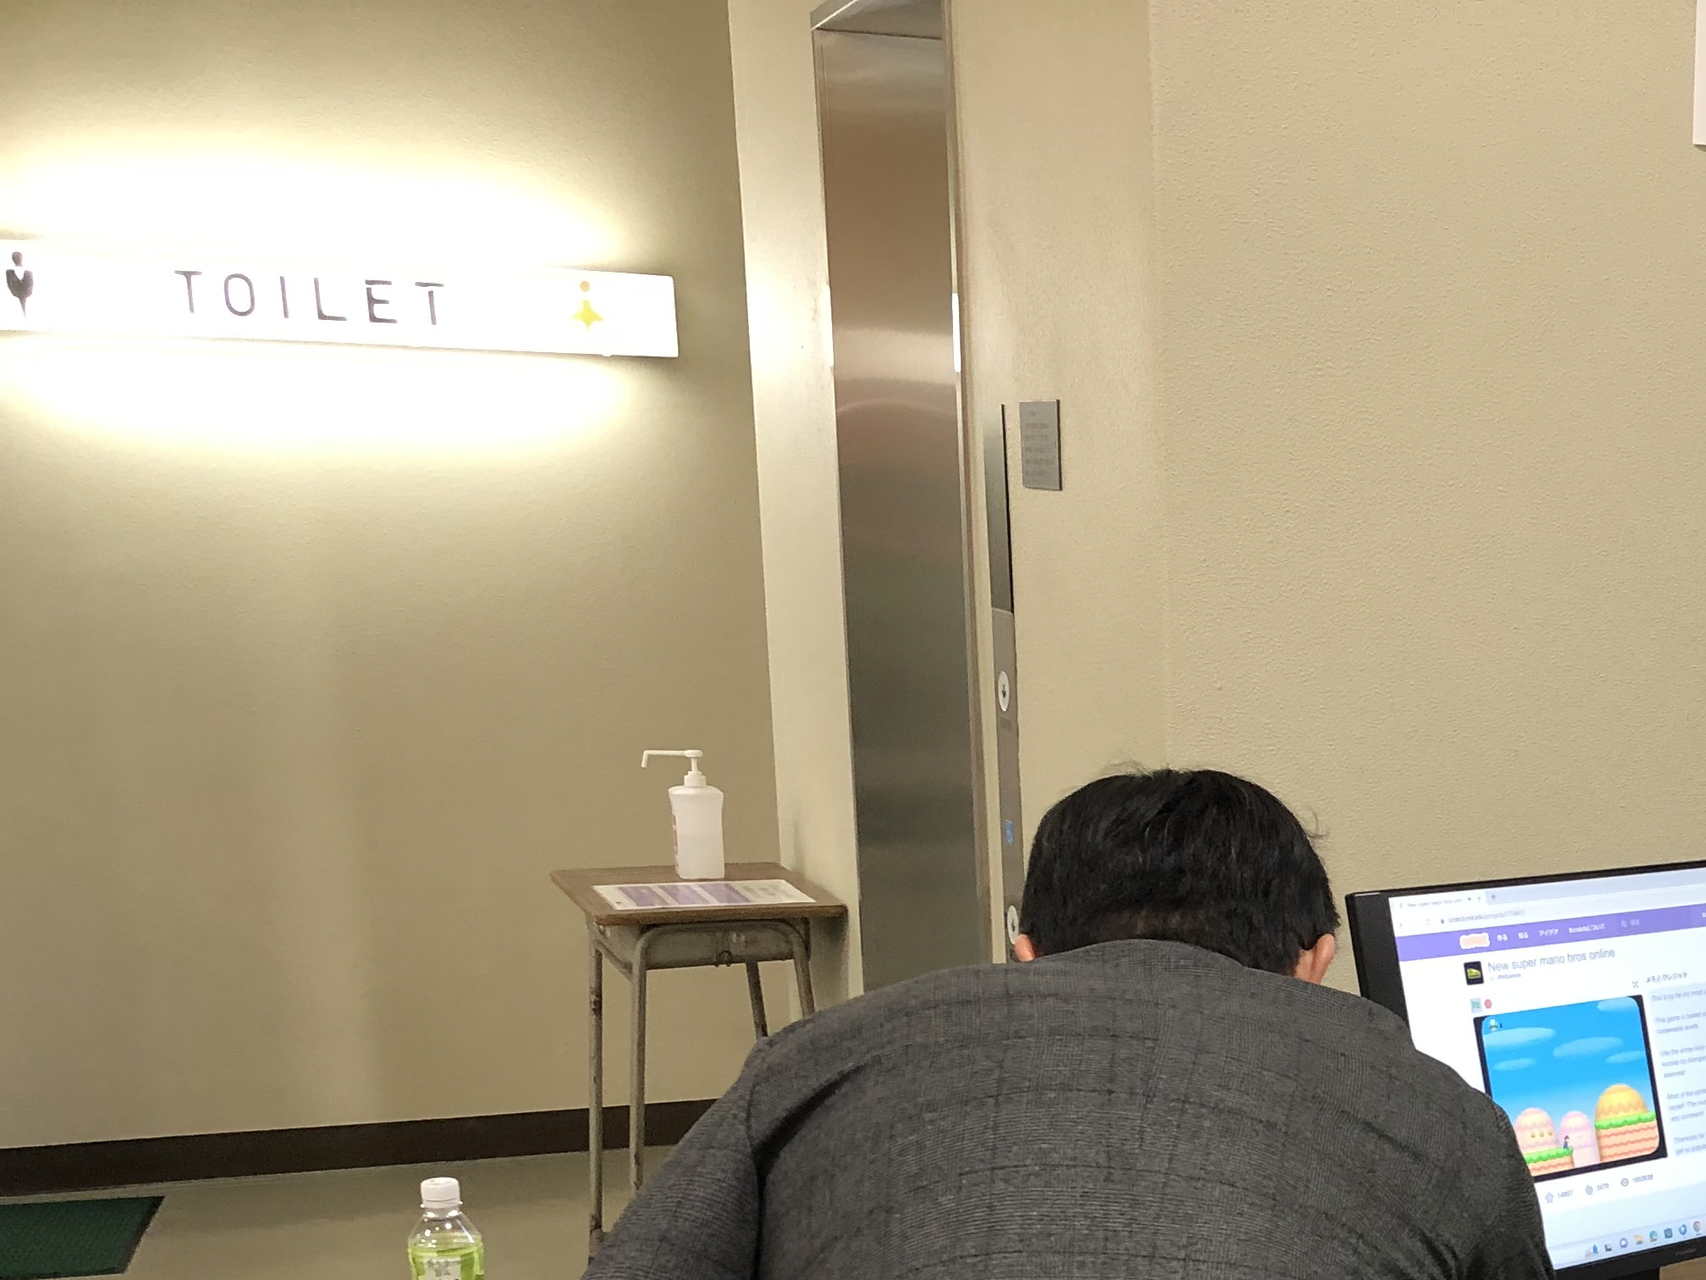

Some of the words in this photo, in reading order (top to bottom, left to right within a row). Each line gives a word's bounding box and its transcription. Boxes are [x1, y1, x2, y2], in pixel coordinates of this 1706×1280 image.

[174, 269, 445, 327] TOILET
[1487, 961, 1509, 973] New
[1511, 958, 1537, 971] super
[1567, 952, 1588, 964] bros
[1588, 948, 1616, 961] online
